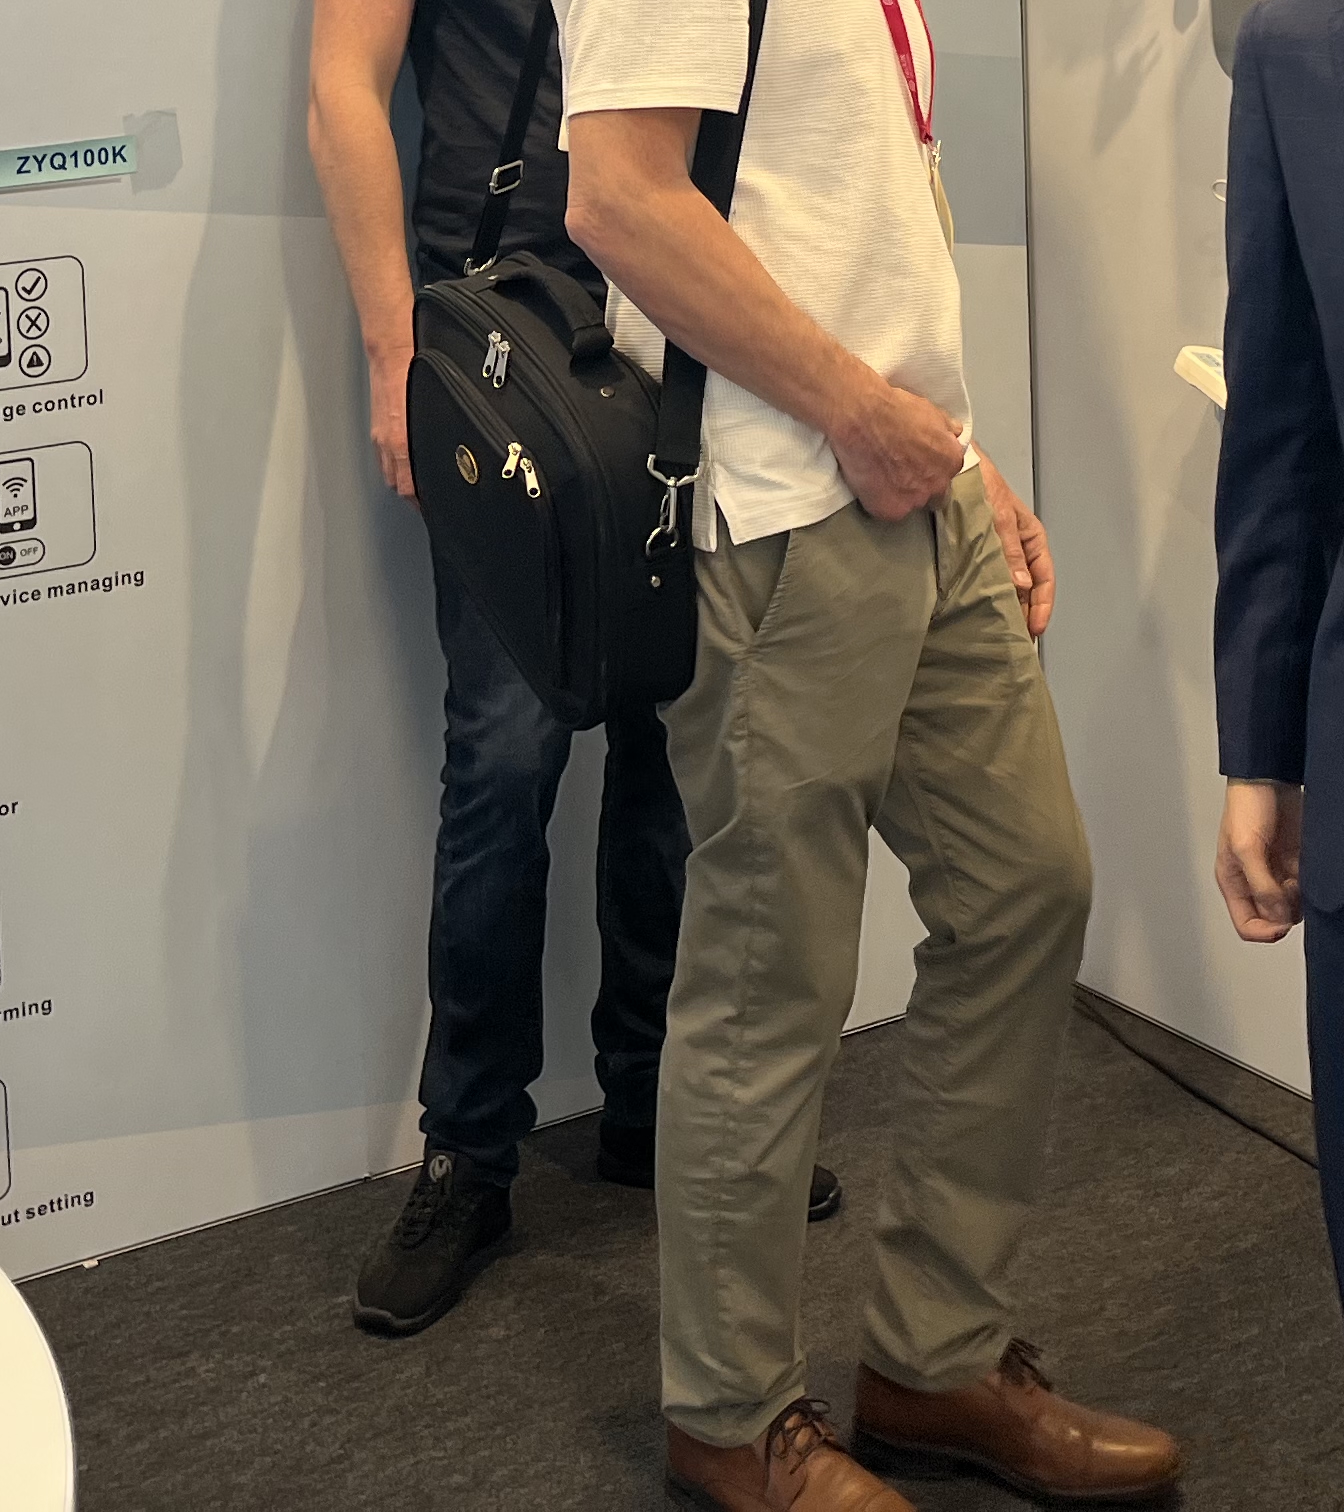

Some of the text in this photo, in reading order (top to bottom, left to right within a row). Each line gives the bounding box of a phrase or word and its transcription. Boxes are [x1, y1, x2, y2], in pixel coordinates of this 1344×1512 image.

[16, 144, 128, 175] ZYQ100K
[32, 389, 104, 414] control
[4, 504, 30, 518] APP
[47, 569, 146, 600] managing
[25, 1191, 95, 1220] setting
